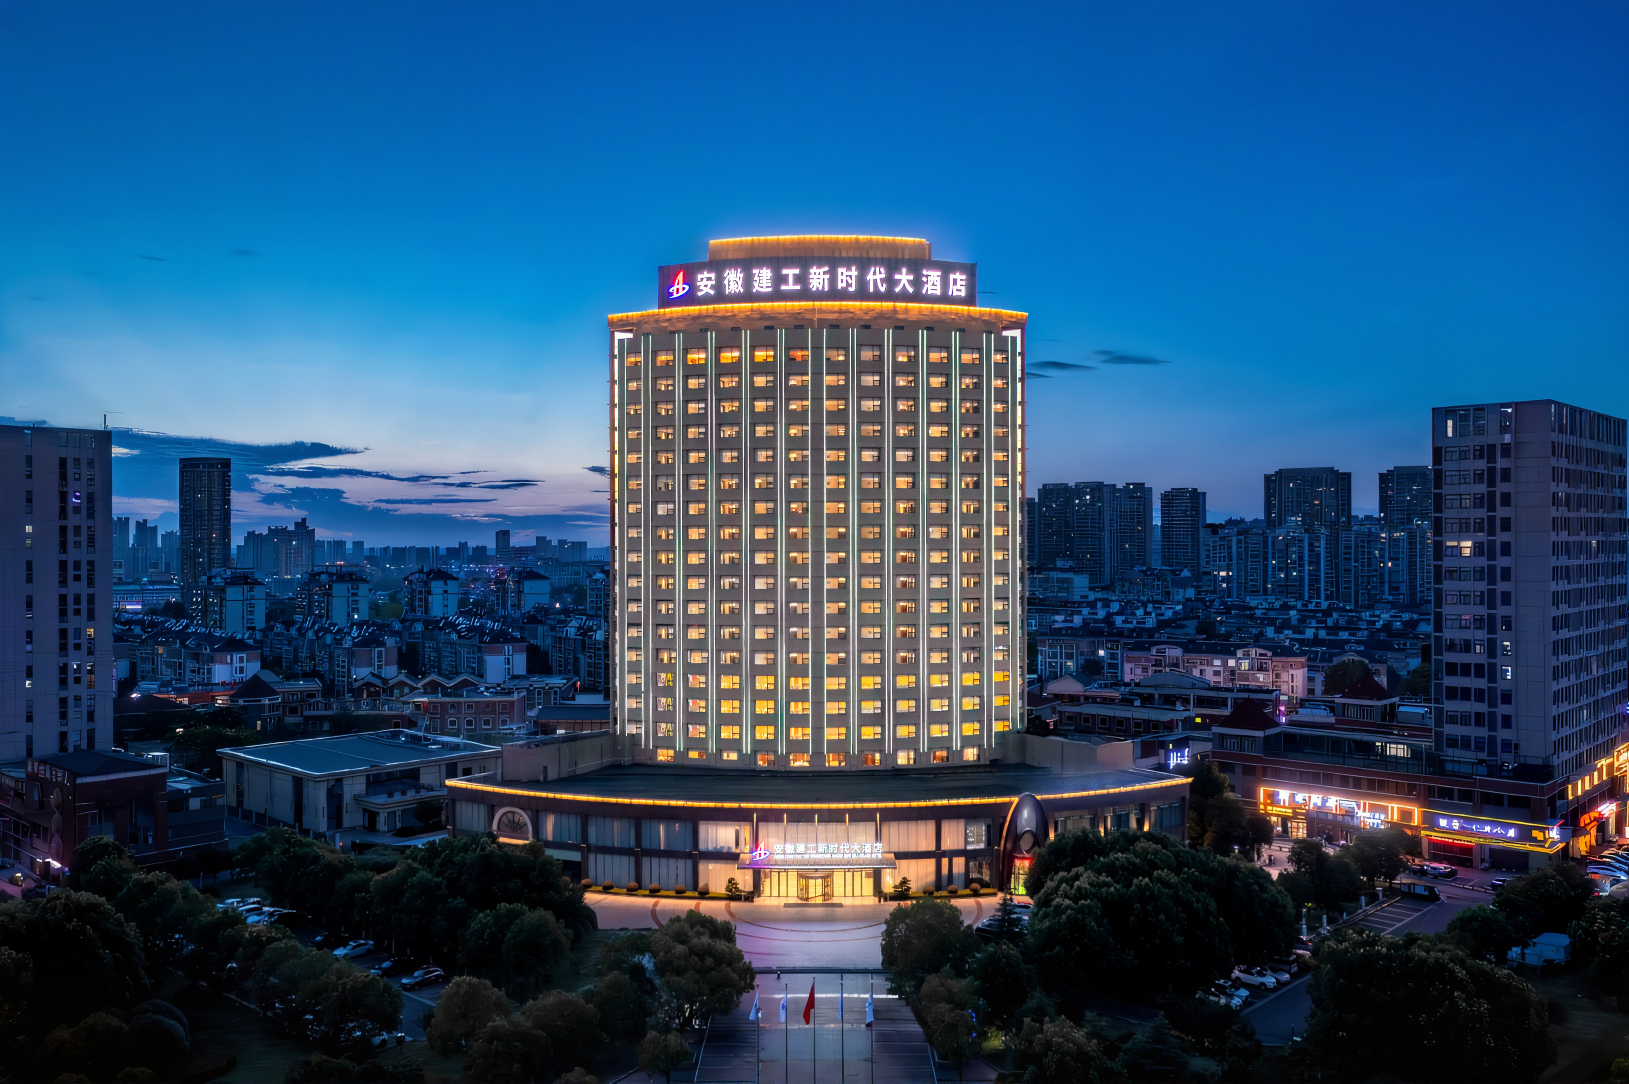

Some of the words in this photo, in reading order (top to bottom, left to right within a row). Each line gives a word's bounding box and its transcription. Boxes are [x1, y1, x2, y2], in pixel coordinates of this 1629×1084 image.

[697, 266, 966, 296] 安徽建工新时代大酒店
[774, 843, 882, 853] 安徽建工新时代大酒店
